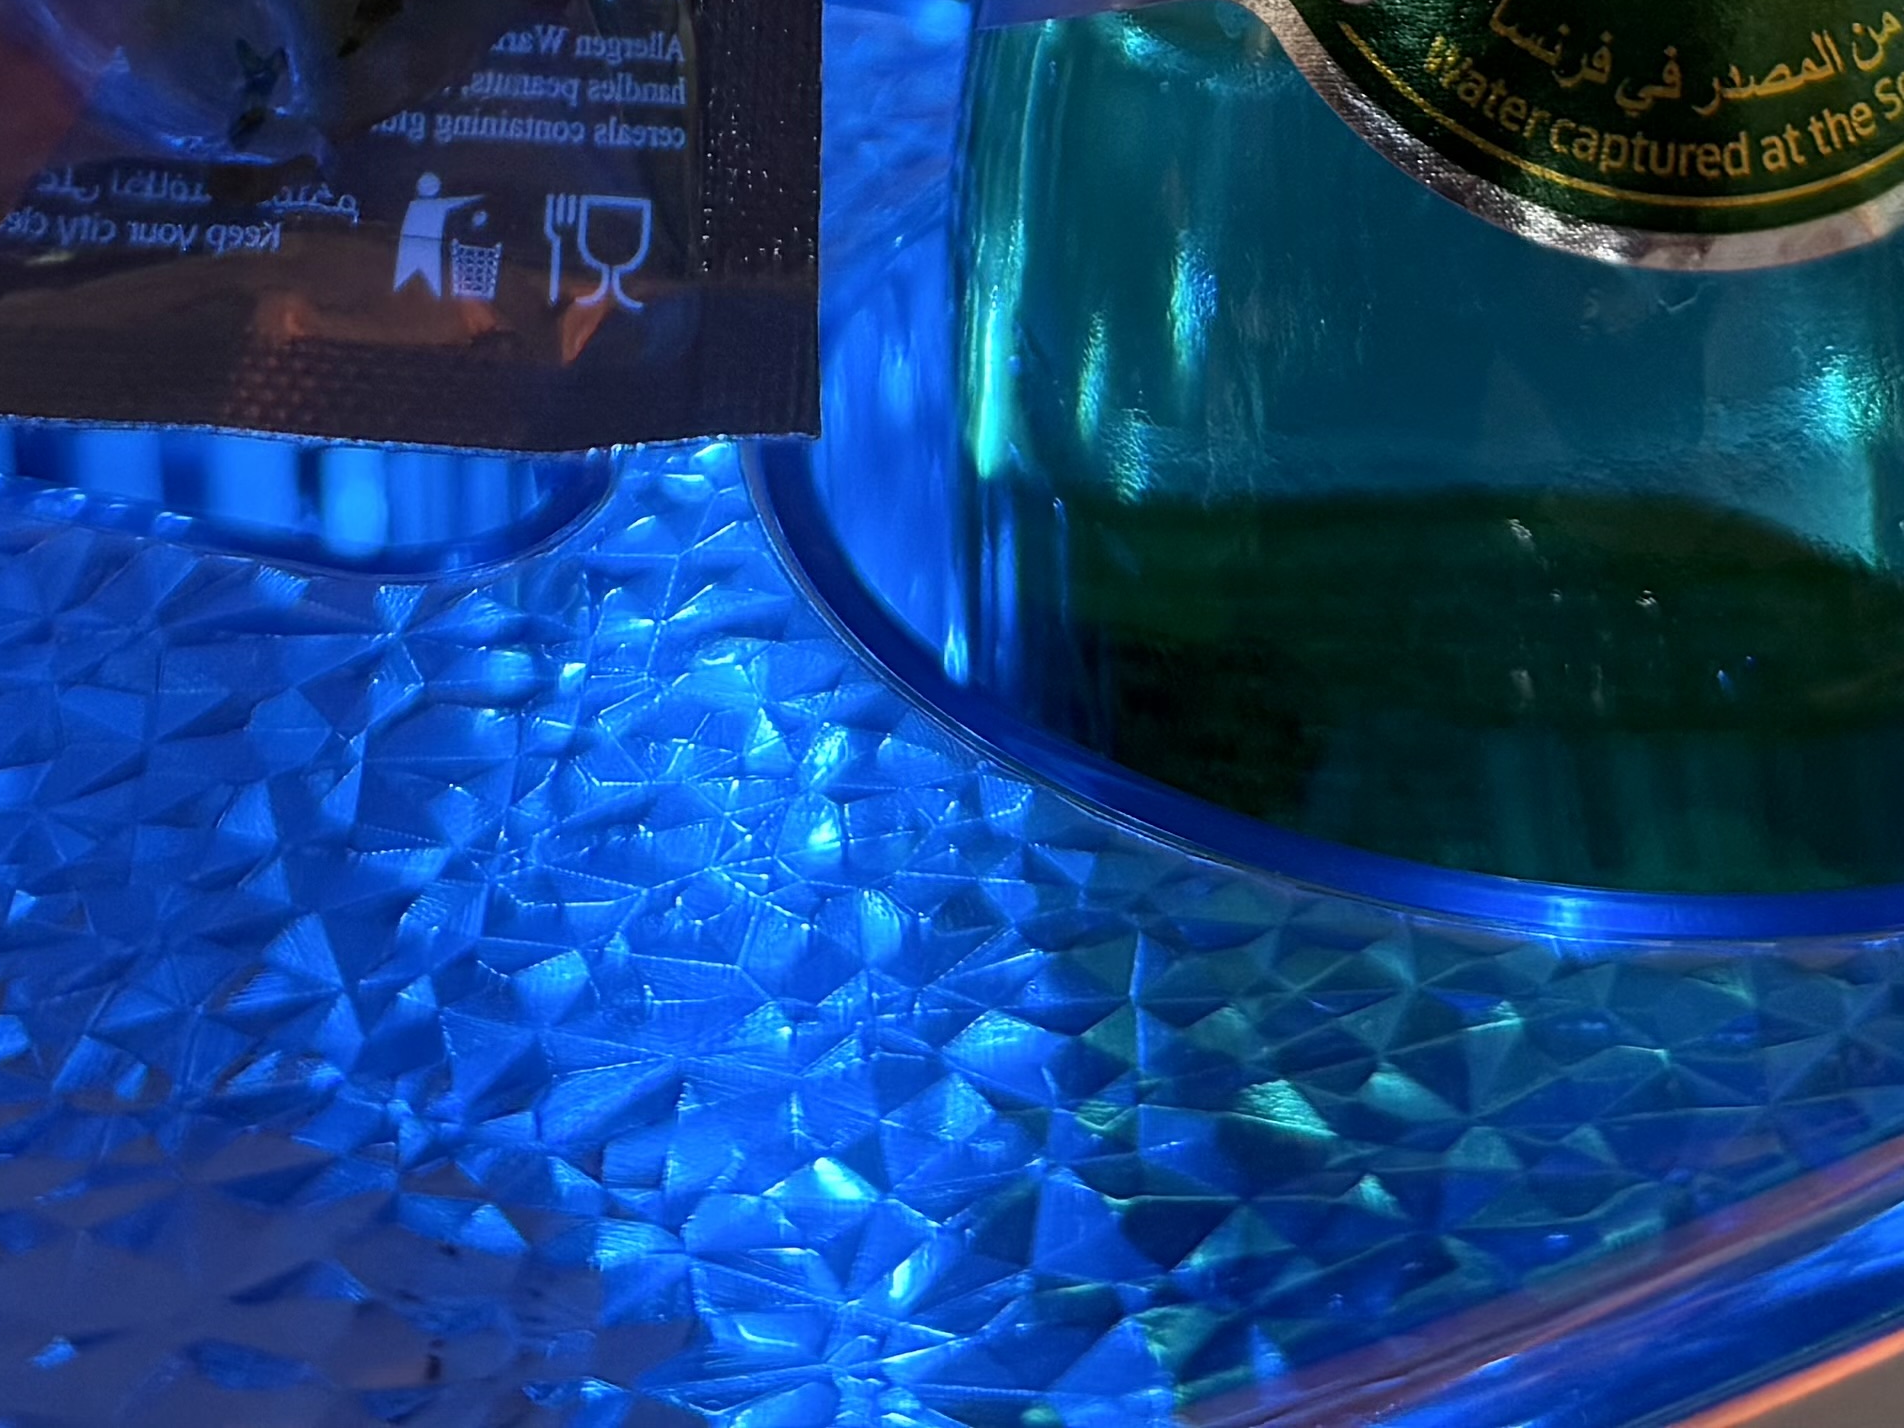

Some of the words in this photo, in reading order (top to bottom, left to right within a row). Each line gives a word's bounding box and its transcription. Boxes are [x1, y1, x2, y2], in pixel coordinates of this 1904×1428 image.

[1423, 30, 1552, 138] Water
[1549, 116, 1749, 176] captured
[1759, 121, 1807, 173] at
[1809, 99, 1878, 157] the
